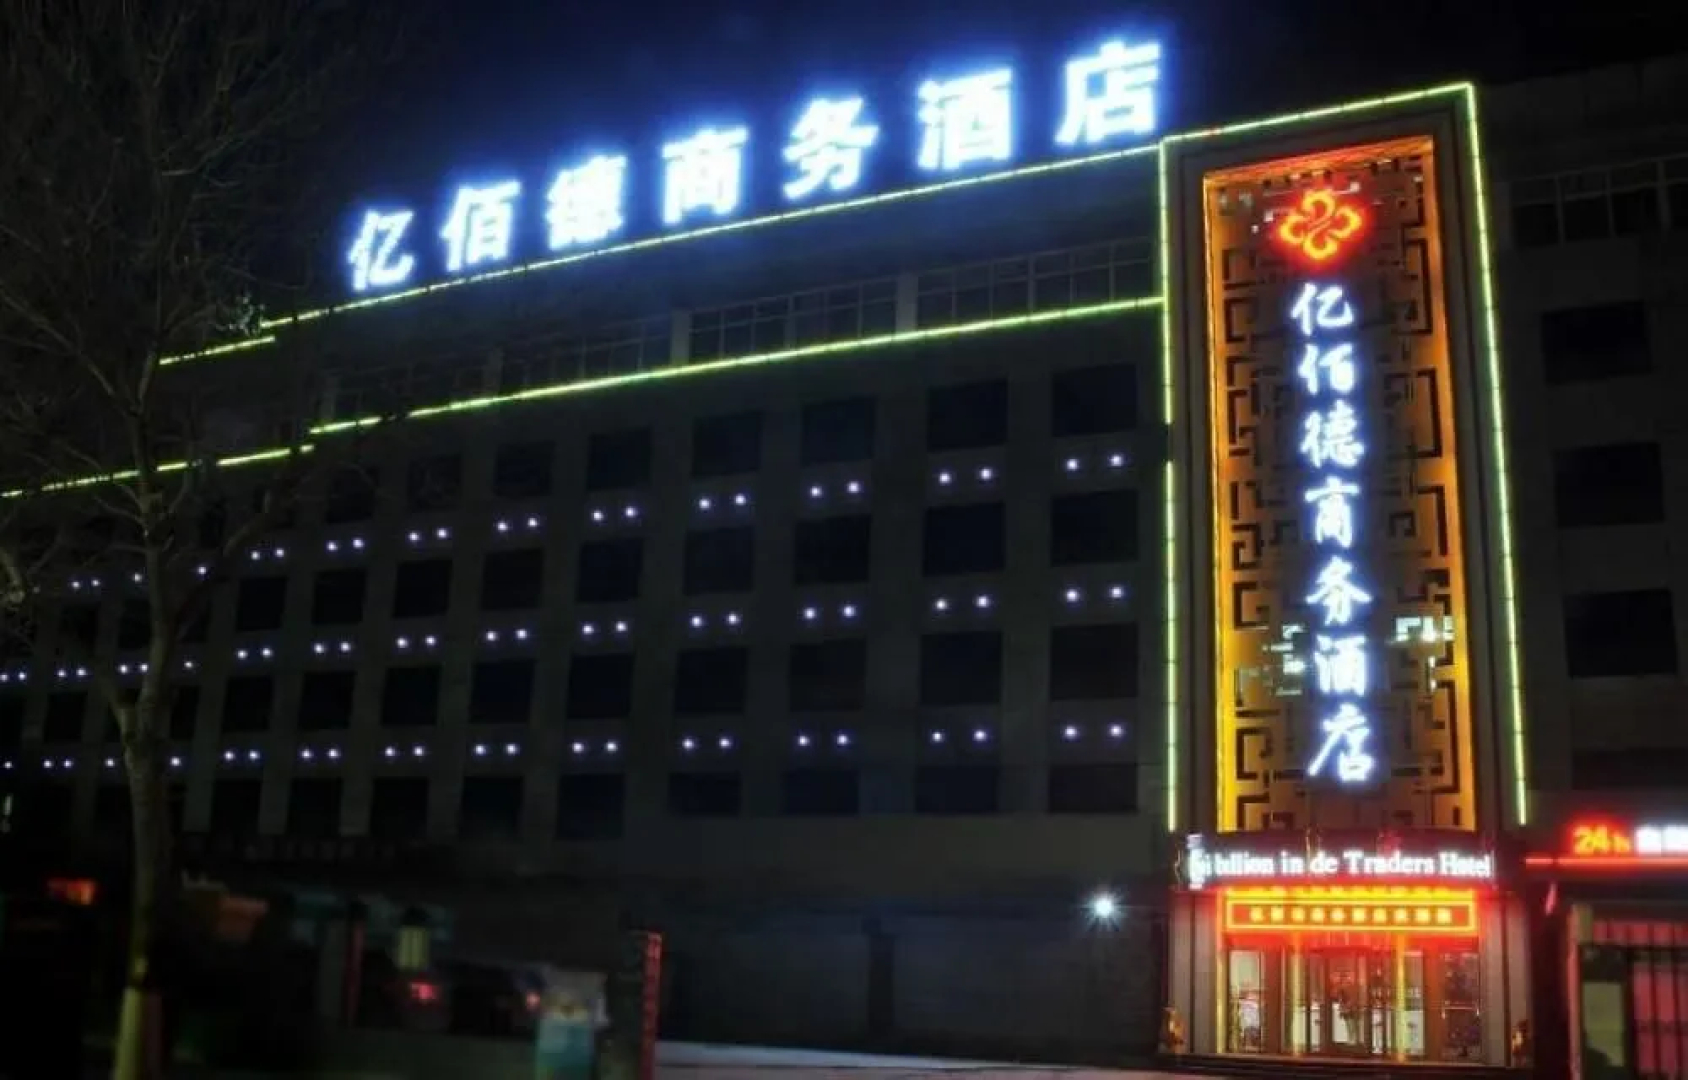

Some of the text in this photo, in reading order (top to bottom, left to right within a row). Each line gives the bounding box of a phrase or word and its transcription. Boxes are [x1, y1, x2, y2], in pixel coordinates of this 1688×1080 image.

[347, 40, 1162, 290] 亿佰德商务酒店
[1290, 281, 1375, 782] 亿佰德商务酒店
[1281, 850, 1305, 875] in
[1310, 849, 1340, 875] de
[1343, 849, 1436, 876] Traders
[1438, 850, 1492, 878] Hotel
